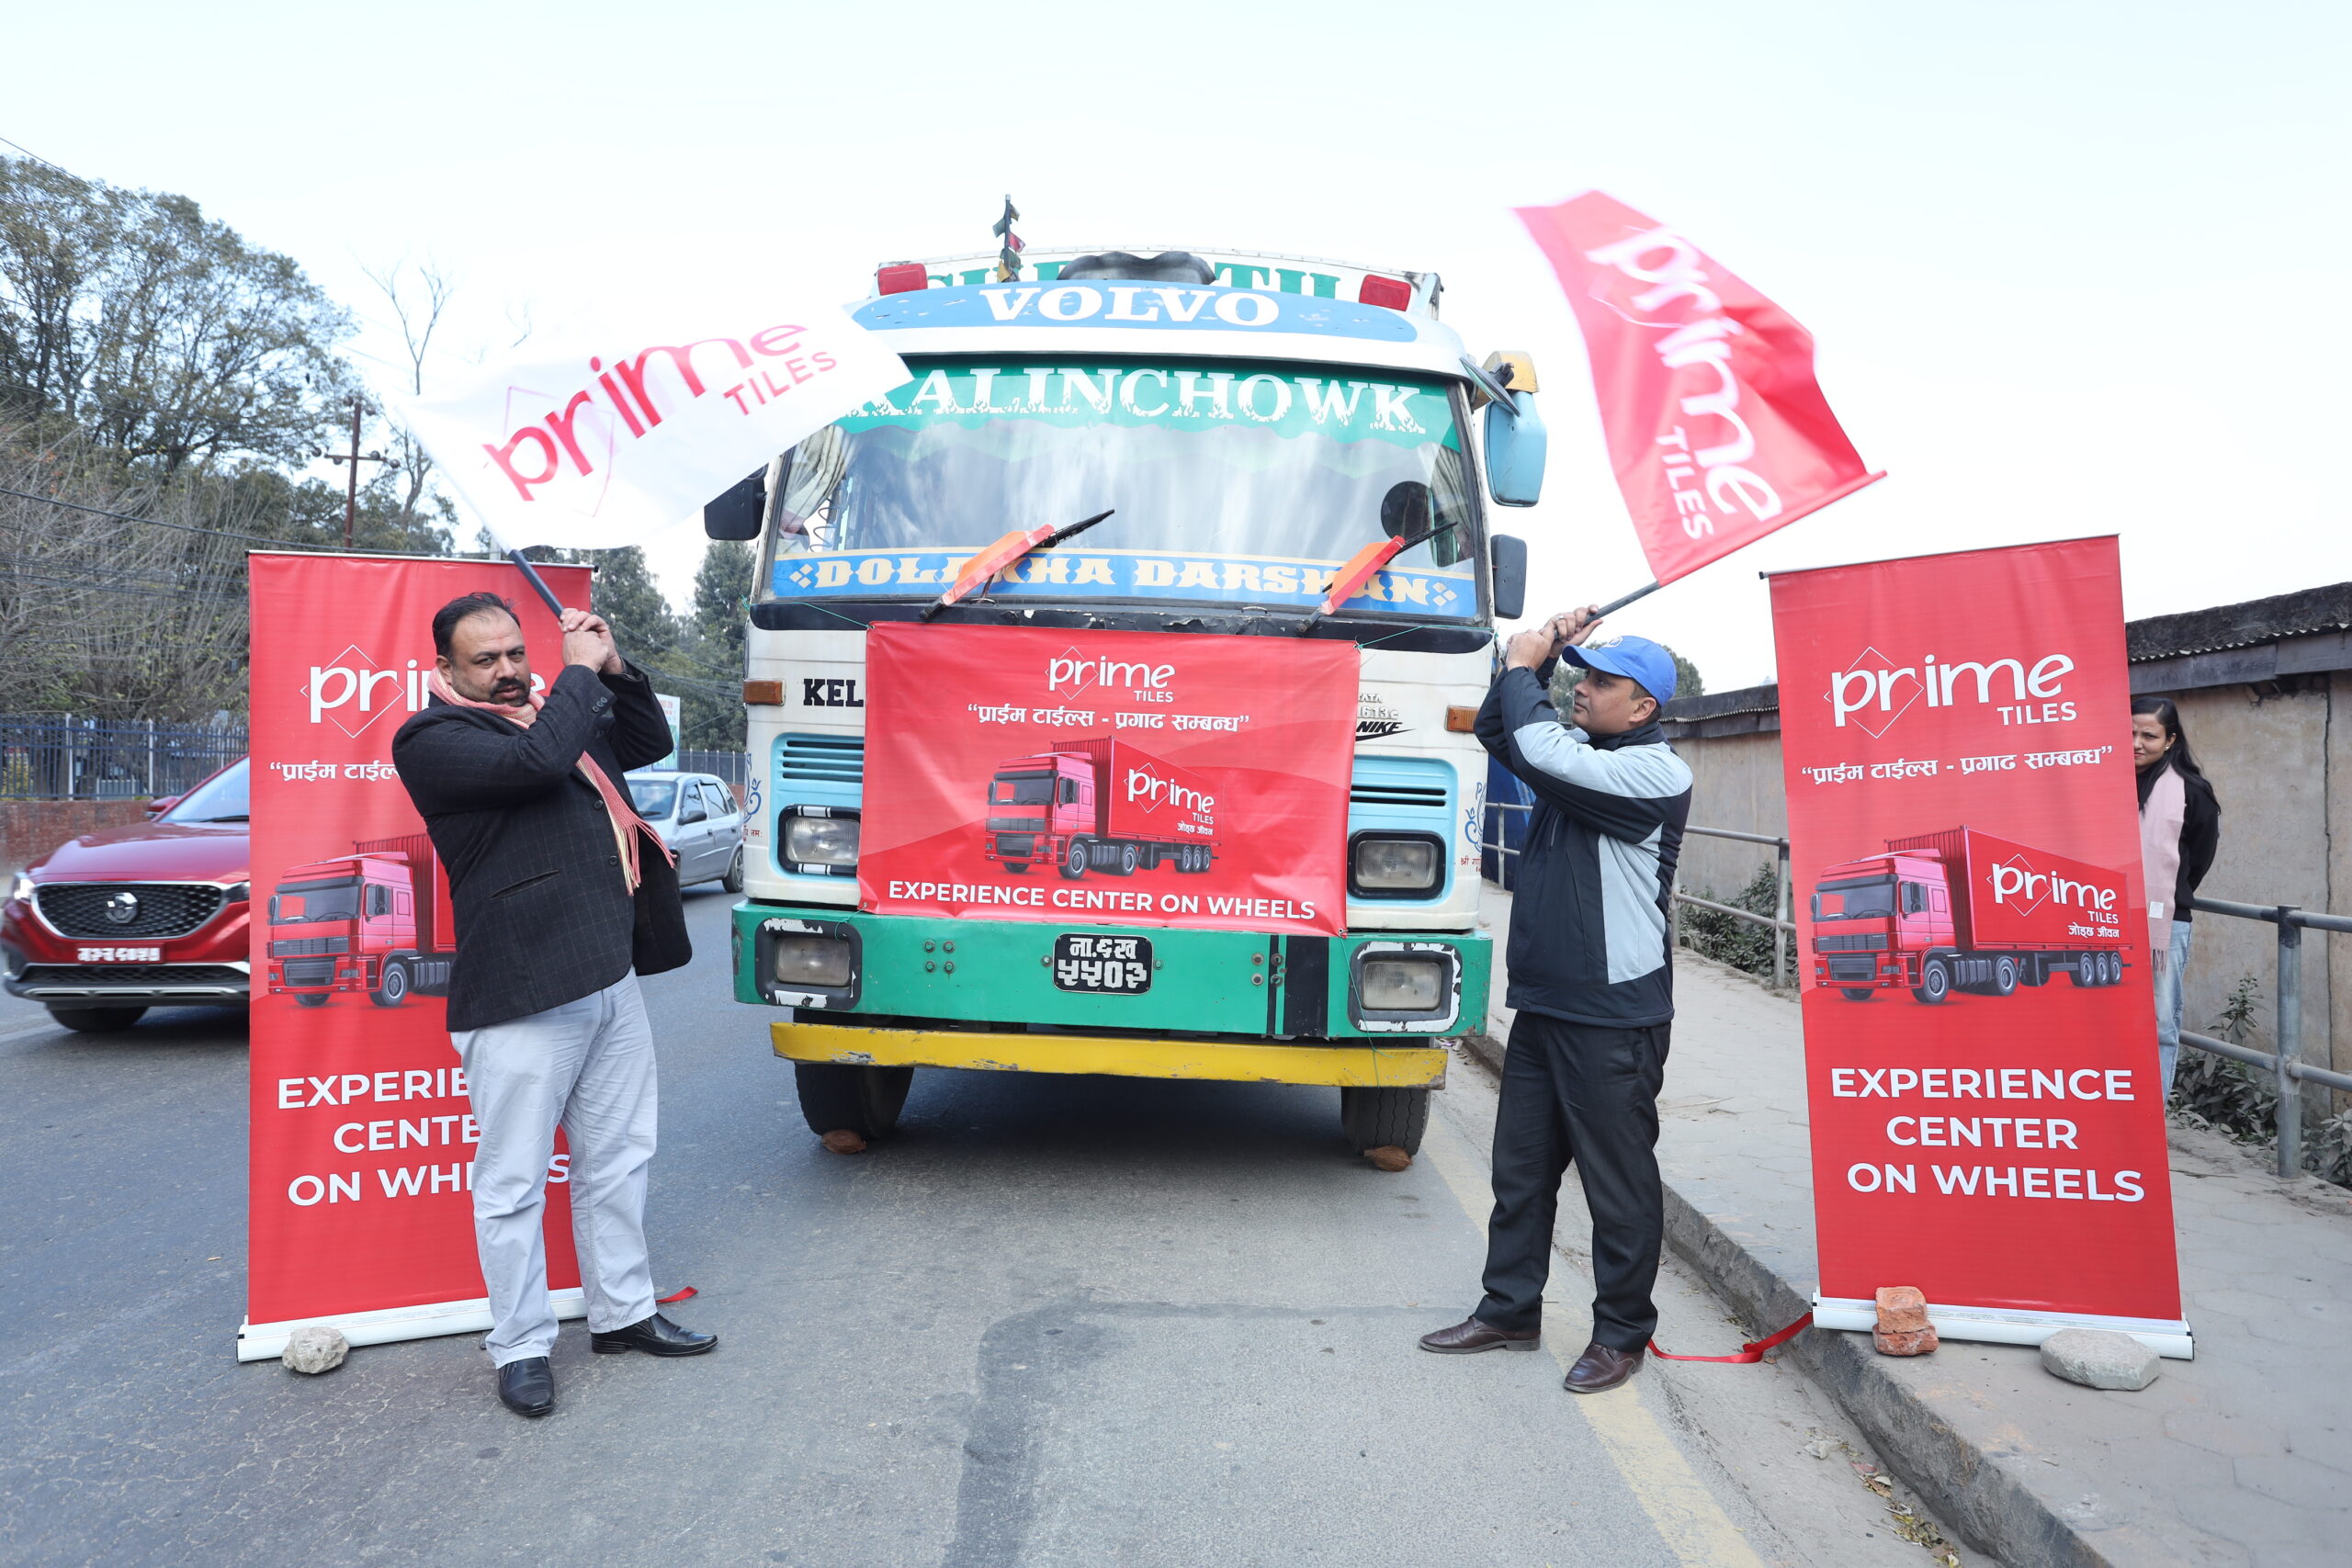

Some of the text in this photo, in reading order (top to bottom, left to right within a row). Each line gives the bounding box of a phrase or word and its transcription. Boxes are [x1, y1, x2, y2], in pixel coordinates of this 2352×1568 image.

[978, 287, 1279, 326] VOLVO
[723, 351, 837, 416] TILES
[1584, 227, 1782, 522] prime
[482, 324, 808, 502] prime
[1656, 425, 1715, 539] TILES
[1048, 655, 1176, 691] prime
[1831, 653, 2075, 728] prime
[804, 678, 865, 707] KEL
[1134, 691, 1174, 703] TILES
[1034, 706, 1095, 728] टाईल्स
[1356, 721, 1403, 734] NIKE
[1996, 702, 2077, 726] TILES
[1871, 757, 1938, 782] टाईल्स
[1128, 768, 1215, 814] prime
[1192, 812, 1214, 825] TILES
[888, 880, 1316, 919] EXPERIENCE CENTER ON WHEELS
[1992, 863, 2117, 910] prime
[2087, 910, 2119, 924] TILES
[278, 1066, 469, 1109] EXPERIE
[1831, 1067, 2134, 1101] EXPERIENCE
[334, 1113, 481, 1154] CENTE
[1886, 1115, 2079, 1150] CENTER
[288, 1171, 361, 1207] ON
[1847, 1162, 2145, 1202] ON WHEELS
